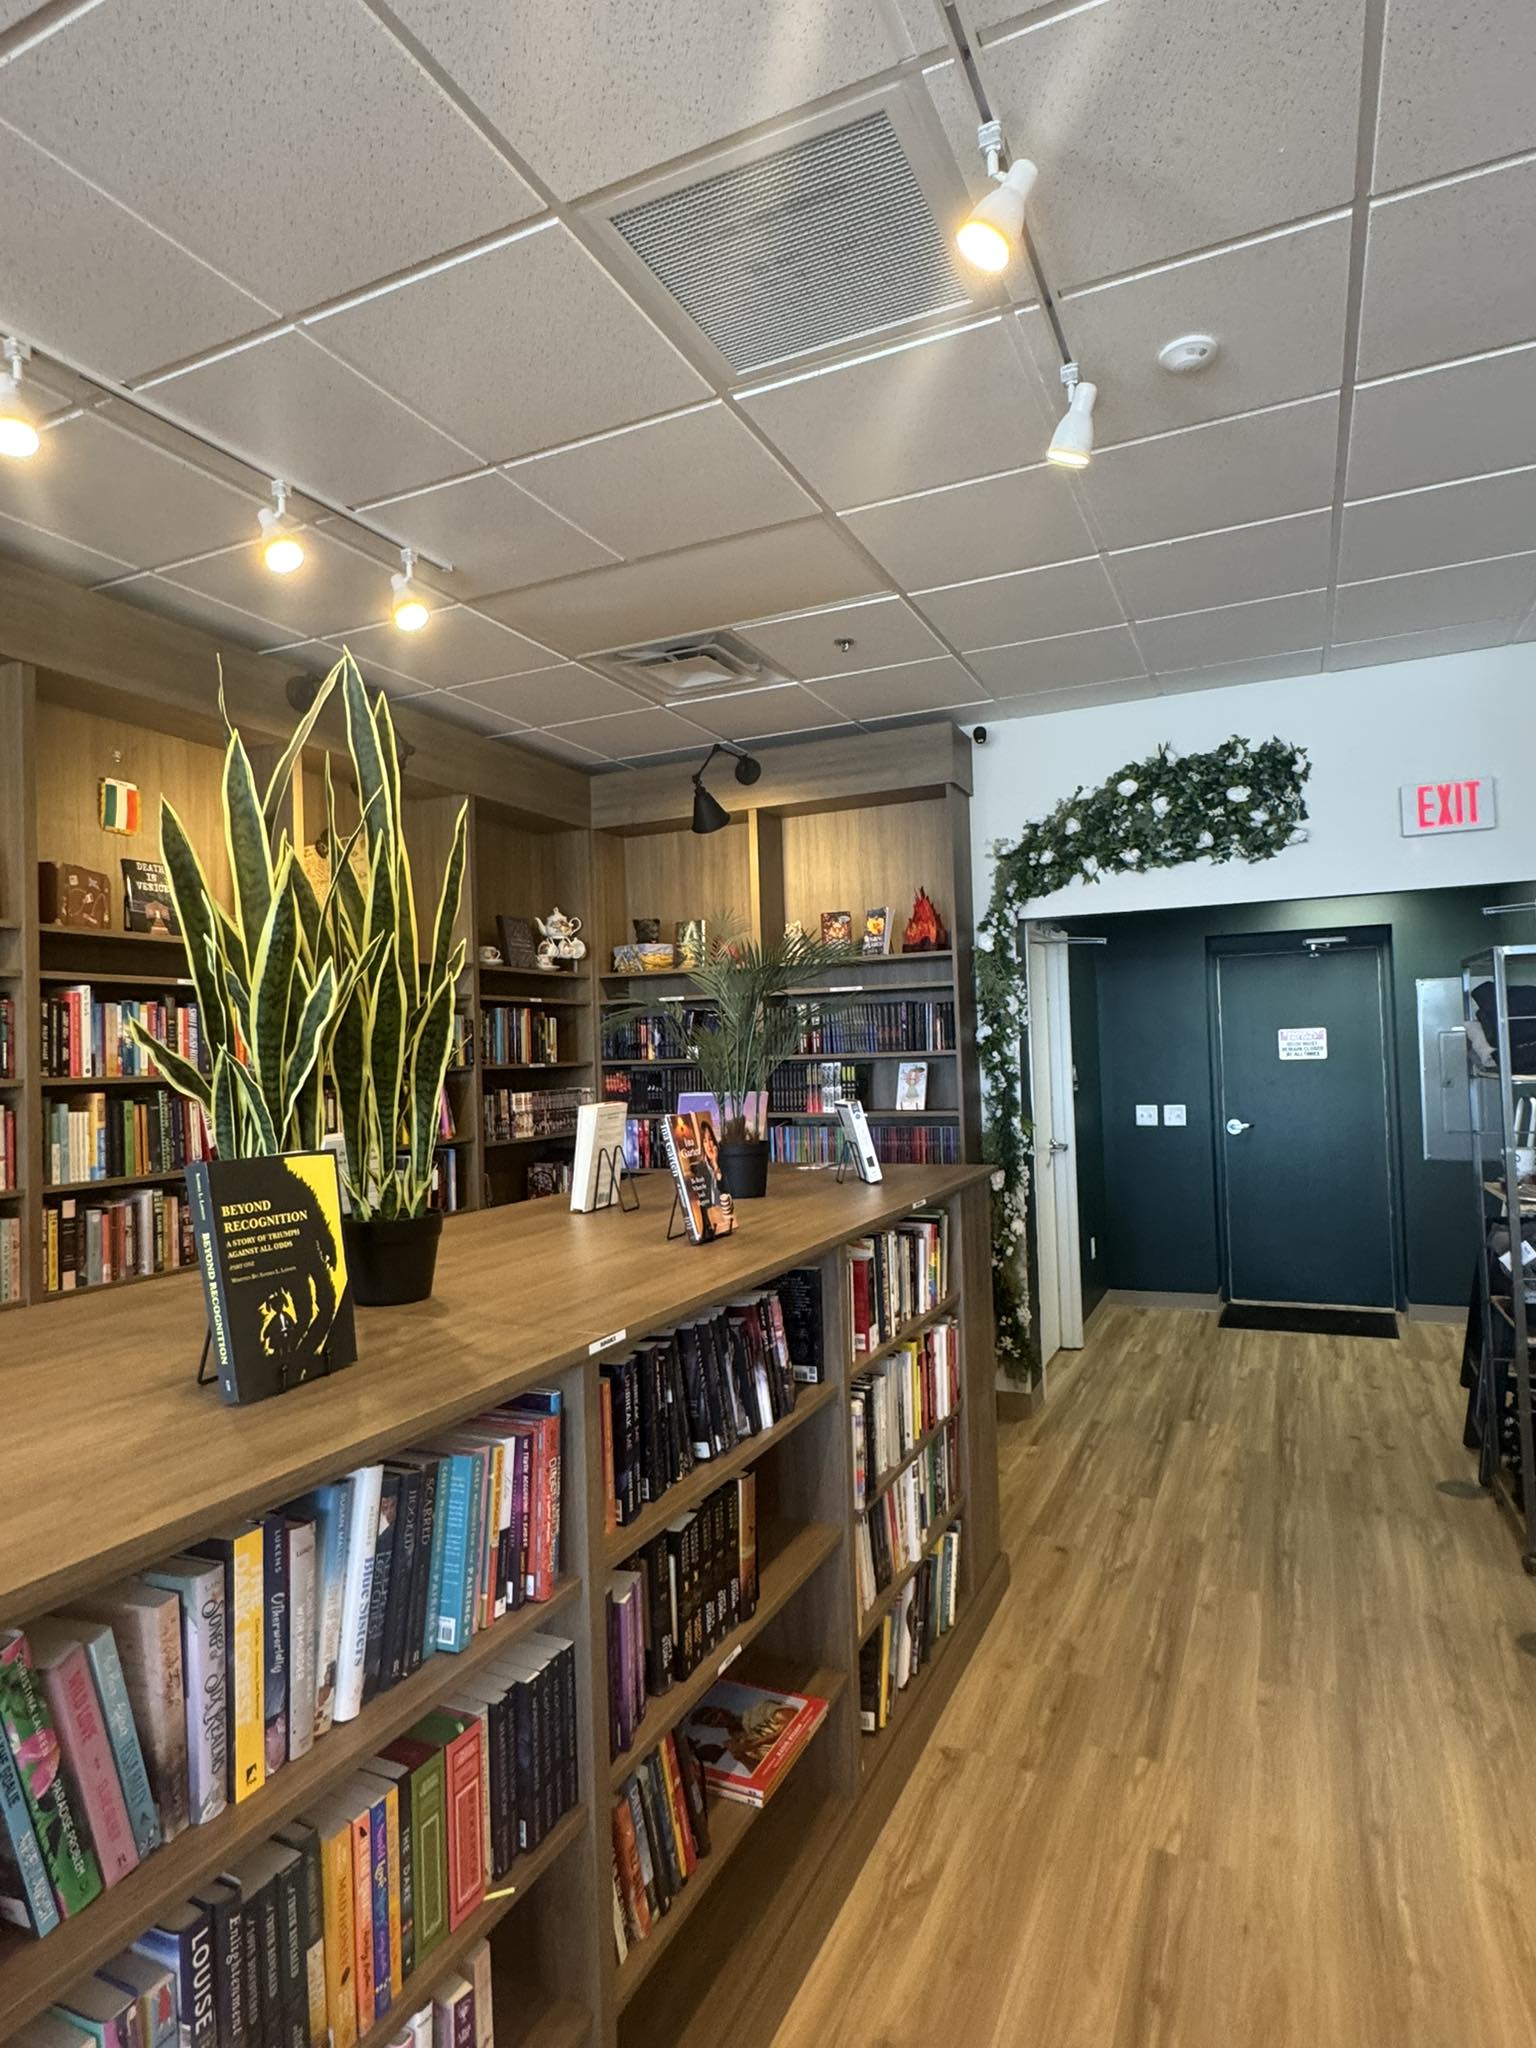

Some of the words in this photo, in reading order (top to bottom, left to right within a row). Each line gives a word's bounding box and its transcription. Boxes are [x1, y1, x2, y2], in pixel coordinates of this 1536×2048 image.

[1416, 780, 1480, 827] EXIT
[136, 862, 165, 874] DEATH
[136, 881, 170, 894] VENICE
[146, 872, 158, 882] IN
[220, 1200, 272, 1217] BEYOND
[223, 1209, 308, 1234] RECOGNITION
[201, 1232, 217, 1281] BEYOND
[226, 1240, 232, 1248] A
[232, 1236, 256, 1248] STORY
[257, 1234, 267, 1242] OF
[268, 1228, 300, 1241] TRIUMPH
[227, 1246, 259, 1259] AGAINST
[260, 1244, 273, 1253] ALL
[273, 1241, 293, 1250] ODDS
[208, 1278, 229, 1366] RECOGNITION
[440, 1465, 448, 1496] CASEY
[473, 1460, 481, 1490] CASEY
[337, 1491, 348, 1530] SUSAN
[404, 1489, 417, 1552] HOOKED
[420, 1478, 434, 1546] SCARRED
[273, 1529, 283, 1574] LUKENS
[360, 1556, 375, 1600] Blue
[464, 1566, 474, 1623] PAIRING
[429, 1574, 439, 1633] PAIRING
[269, 1592, 286, 1674] Otherworldly
[354, 1601, 371, 1668] Sisters
[69, 1670, 92, 1710] WILD
[204, 1672, 226, 1709] SIX
[234, 1631, 251, 1729] FOREST
[15, 1651, 36, 1712] CHRISTINA
[30, 1711, 49, 1758] LAUREN
[76, 1710, 97, 1744] LOVE
[203, 1705, 227, 1776] REALMS
[1, 1764, 23, 1808] GOALIE
[51, 1777, 73, 1832] PARADISE
[64, 1830, 87, 1876] PROBLEM
[402, 1827, 411, 1854] THE
[336, 1874, 348, 1912] MAD
[374, 1859, 387, 1888] Love
[402, 1865, 412, 1904] DARE
[289, 1926, 300, 1978] REVEALED
[338, 1915, 350, 1967] HONEY
[191, 1926, 213, 2036] LOUISE
[225, 1913, 243, 2036] Enlightenment
[268, 1948, 278, 1999] REVEALED
